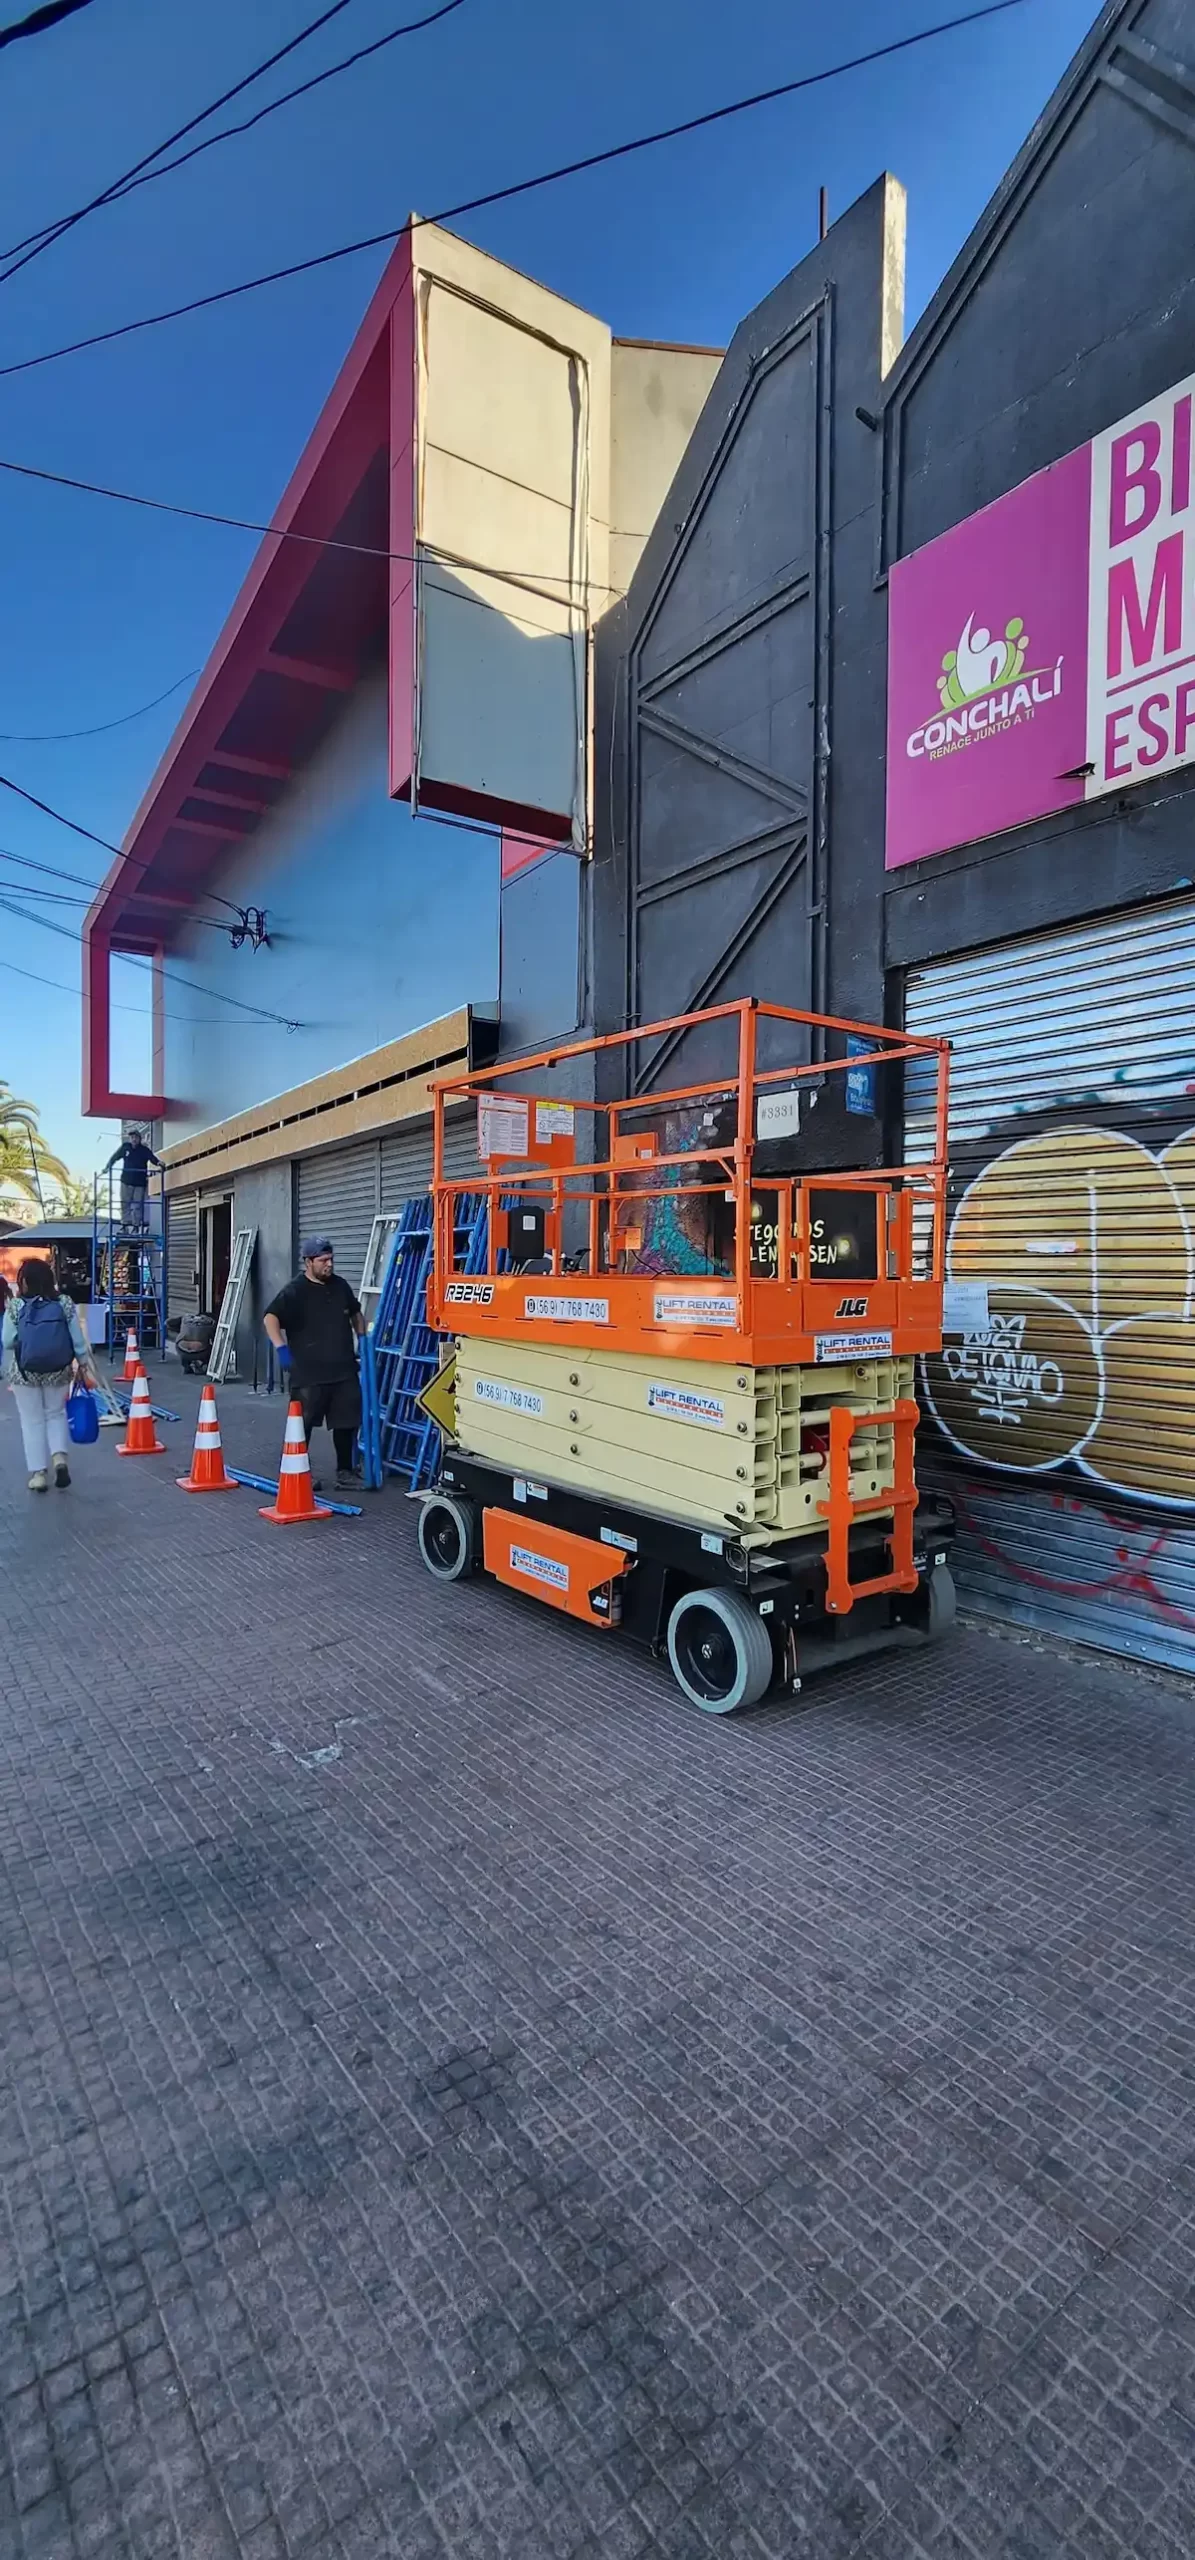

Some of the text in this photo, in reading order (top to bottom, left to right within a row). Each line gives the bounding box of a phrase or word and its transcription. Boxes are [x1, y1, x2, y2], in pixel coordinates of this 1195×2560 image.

[1109, 393, 1192, 549] BI
[906, 655, 1064, 757] CONCHALÍ
[929, 734, 972, 761] RENACE
[973, 720, 1011, 742] JUNTO
[1013, 714, 1022, 726] A
[761, 1105, 794, 1119] #3331
[445, 1283, 494, 1304] R3246
[536, 1300, 549, 1315] (56
[568, 1302, 582, 1317] 768
[585, 1302, 606, 1318] 7430
[663, 1300, 735, 1310] LIFT RENTAL
[835, 1298, 868, 1317] JLG
[823, 1336, 890, 1348] LIFT RENTAL
[484, 1383, 494, 1399] (56
[510, 1391, 521, 1407] 768
[524, 1395, 541, 1412] 7430
[656, 1389, 676, 1399] LIFT
[679, 1394, 723, 1412] RENTAL
[516, 1551, 533, 1563] LIFT
[534, 1559, 566, 1577] RENTAL
